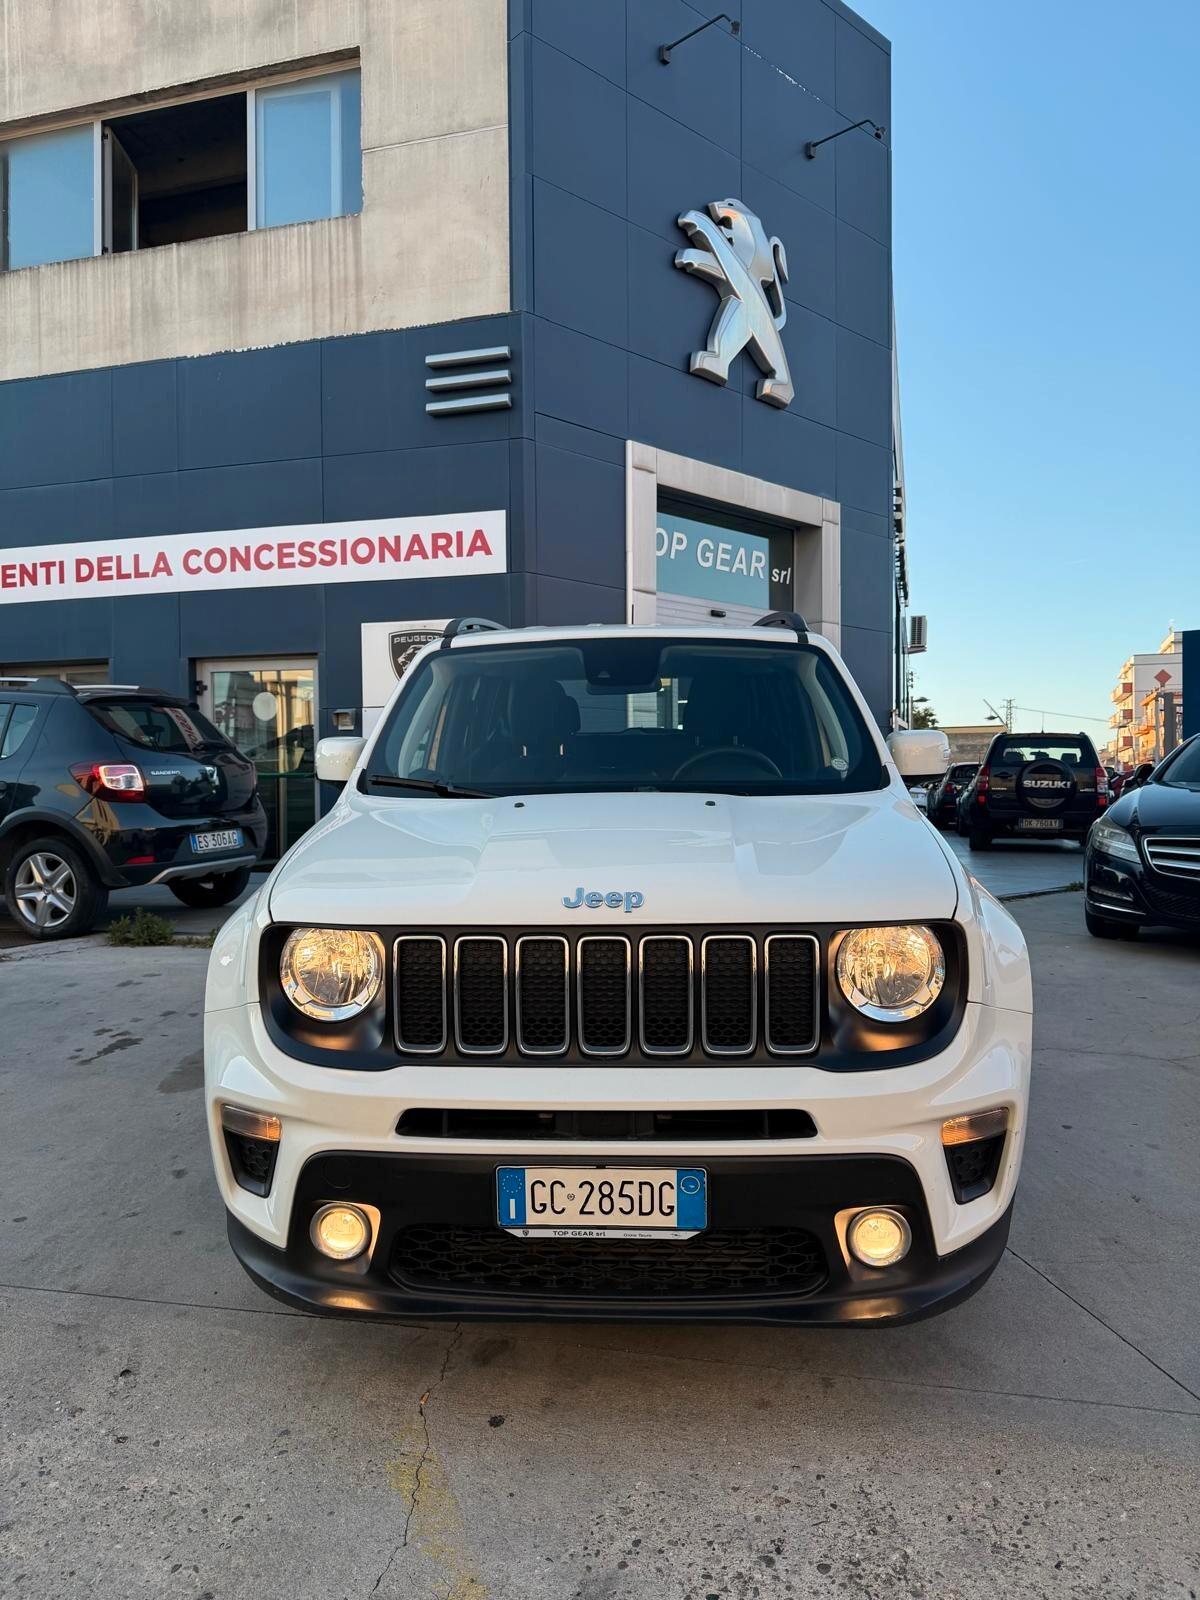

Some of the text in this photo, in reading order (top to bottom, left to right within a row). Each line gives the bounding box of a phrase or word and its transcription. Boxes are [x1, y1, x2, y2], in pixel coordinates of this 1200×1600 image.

[75, 552, 172, 584] DELLA
[183, 528, 492, 575] CONCESSIONARIA
[696, 538, 766, 579] GEAR
[771, 567, 792, 585] srl
[1023, 780, 1071, 789] SUZUKI
[197, 834, 209, 849] ES
[562, 887, 644, 913] Jeep
[530, 1179, 675, 1217] GC 285DG
